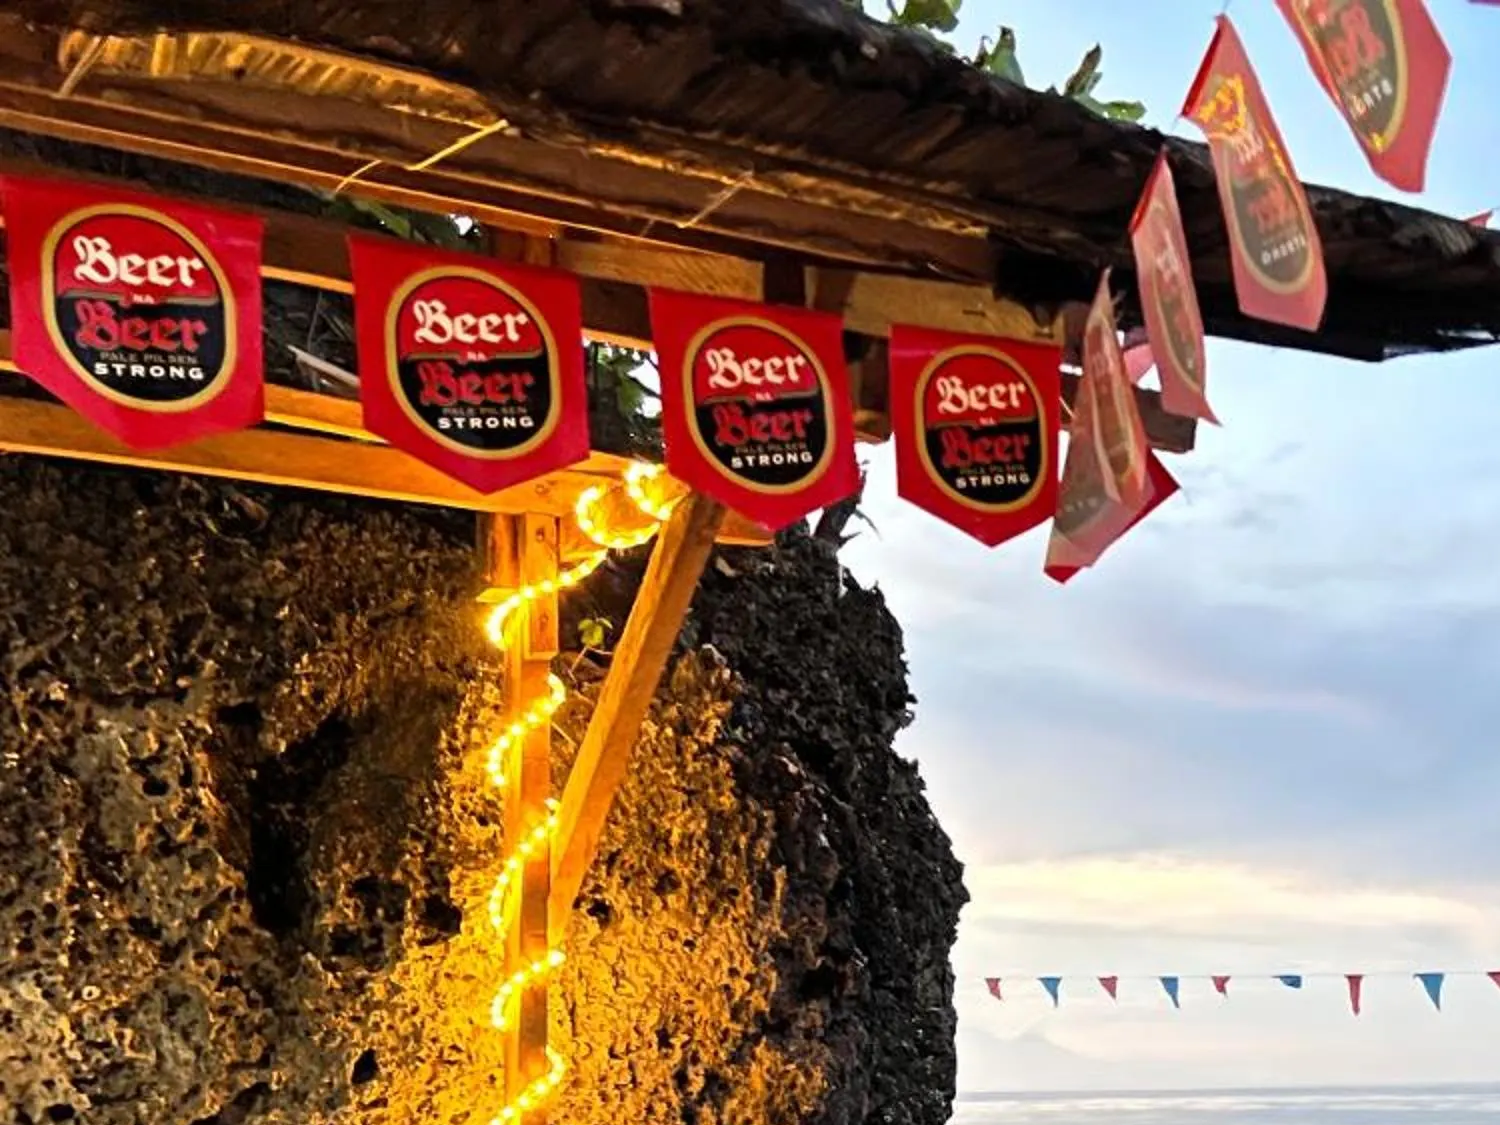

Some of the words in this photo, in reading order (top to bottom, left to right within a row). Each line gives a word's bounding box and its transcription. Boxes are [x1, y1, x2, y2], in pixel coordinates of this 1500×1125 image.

[72, 235, 204, 287] Beer
[75, 300, 208, 352] Beer
[413, 299, 529, 344] Beer
[94, 362, 204, 380] STRONG
[418, 361, 535, 406] Beer
[705, 347, 806, 389] Beer
[936, 375, 1026, 414] Beer
[437, 416, 535, 429] STRONG
[713, 403, 813, 446] Beer
[731, 451, 813, 469] STRONG
[941, 427, 1031, 468] Beer
[955, 472, 1031, 489] STRONG
